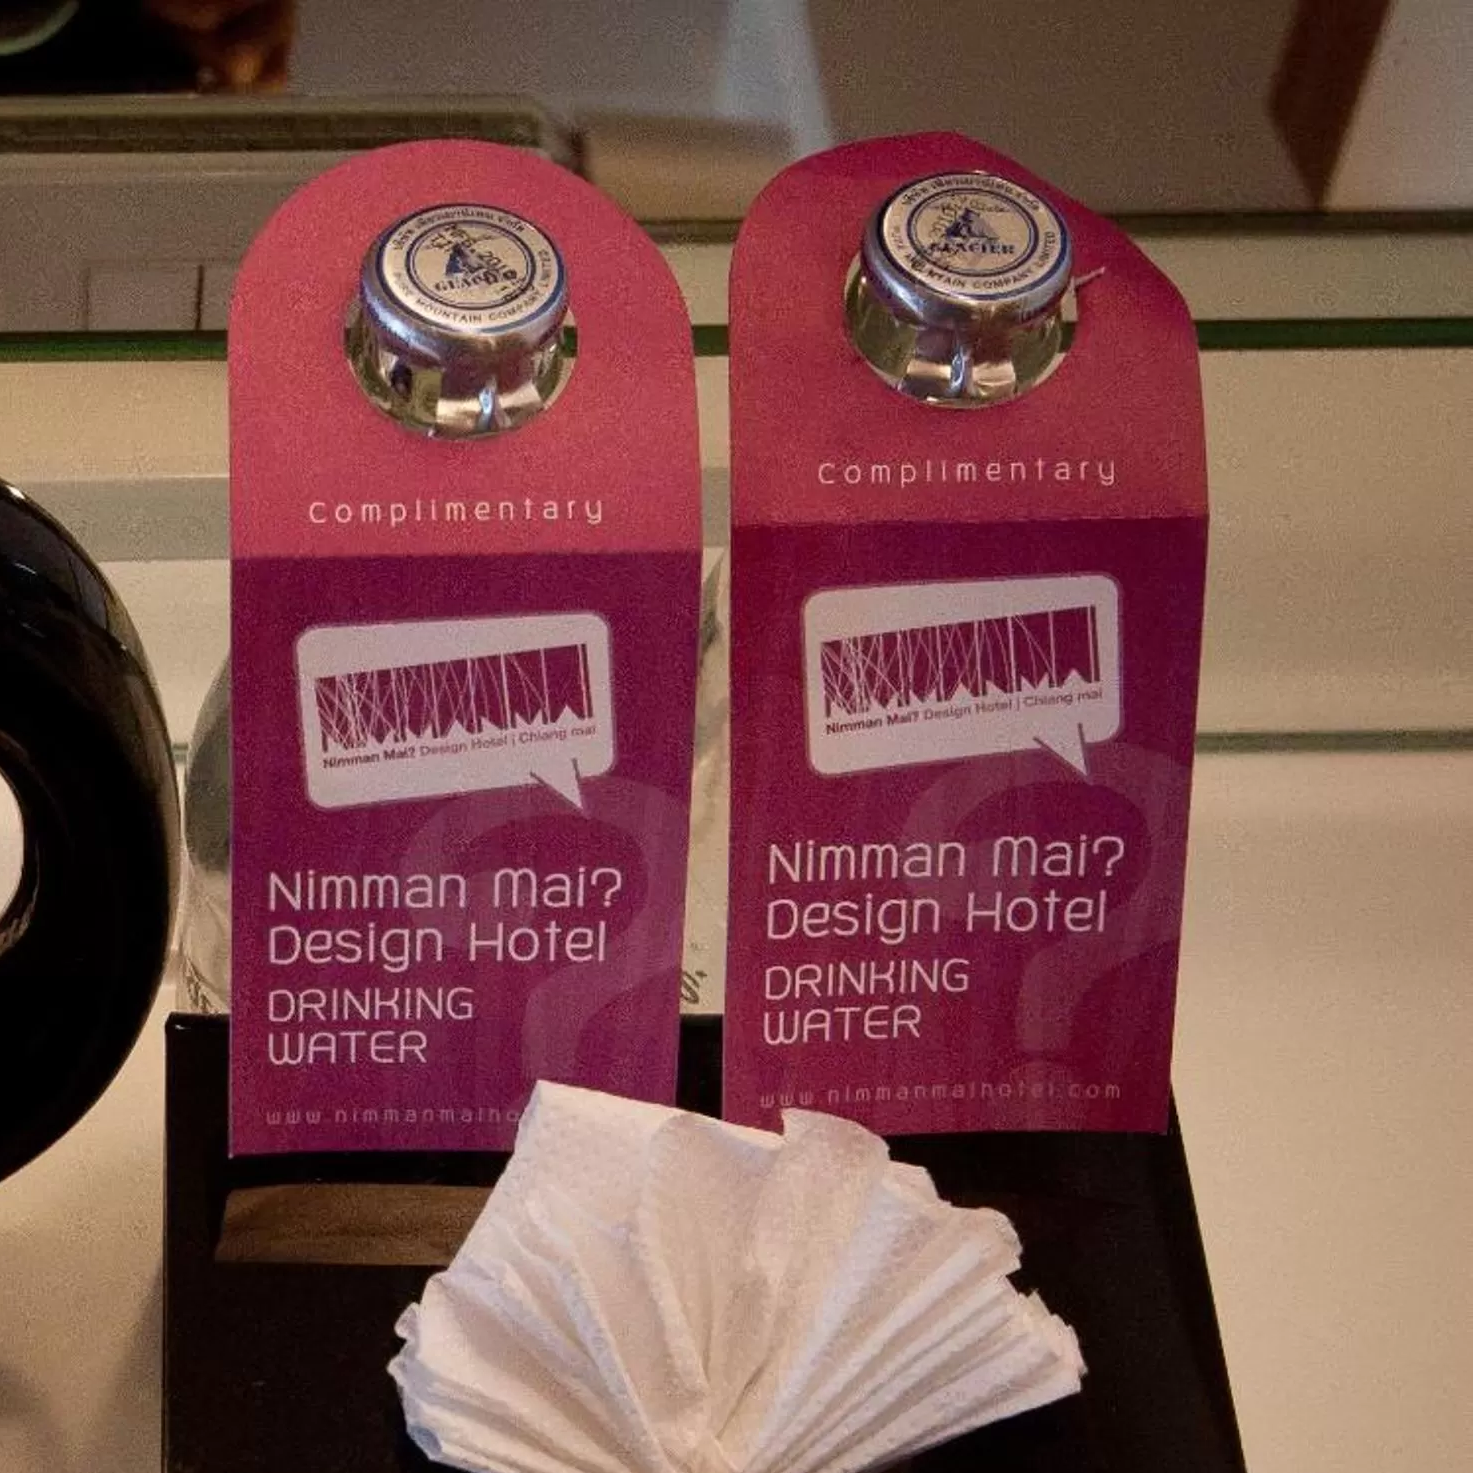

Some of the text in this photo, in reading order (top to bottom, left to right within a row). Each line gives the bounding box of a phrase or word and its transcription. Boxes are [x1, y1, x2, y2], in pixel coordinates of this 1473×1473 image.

[415, 298, 483, 323] MOUNTAIN
[818, 459, 1117, 488] Complimentary
[308, 499, 604, 527] Complimentary
[825, 716, 884, 736] Nimman
[886, 710, 920, 729] Mai?
[923, 703, 972, 722] Design
[975, 698, 1014, 716] Hotel
[1022, 692, 1075, 712] Chiang
[323, 750, 381, 770] Nimman
[419, 739, 469, 760] Design
[470, 733, 509, 753] Hotel
[518, 726, 568, 748] Chiang
[768, 834, 1126, 885] Nimman Mai?
[268, 866, 624, 912] Nimman Mai?
[765, 889, 1107, 946] Design Hotel
[268, 920, 607, 972] Design Hotel
[763, 957, 971, 1002] DRINKING
[268, 986, 475, 1023] DRINKING
[762, 1005, 924, 1046] WATER
[267, 1029, 429, 1066] WATER
